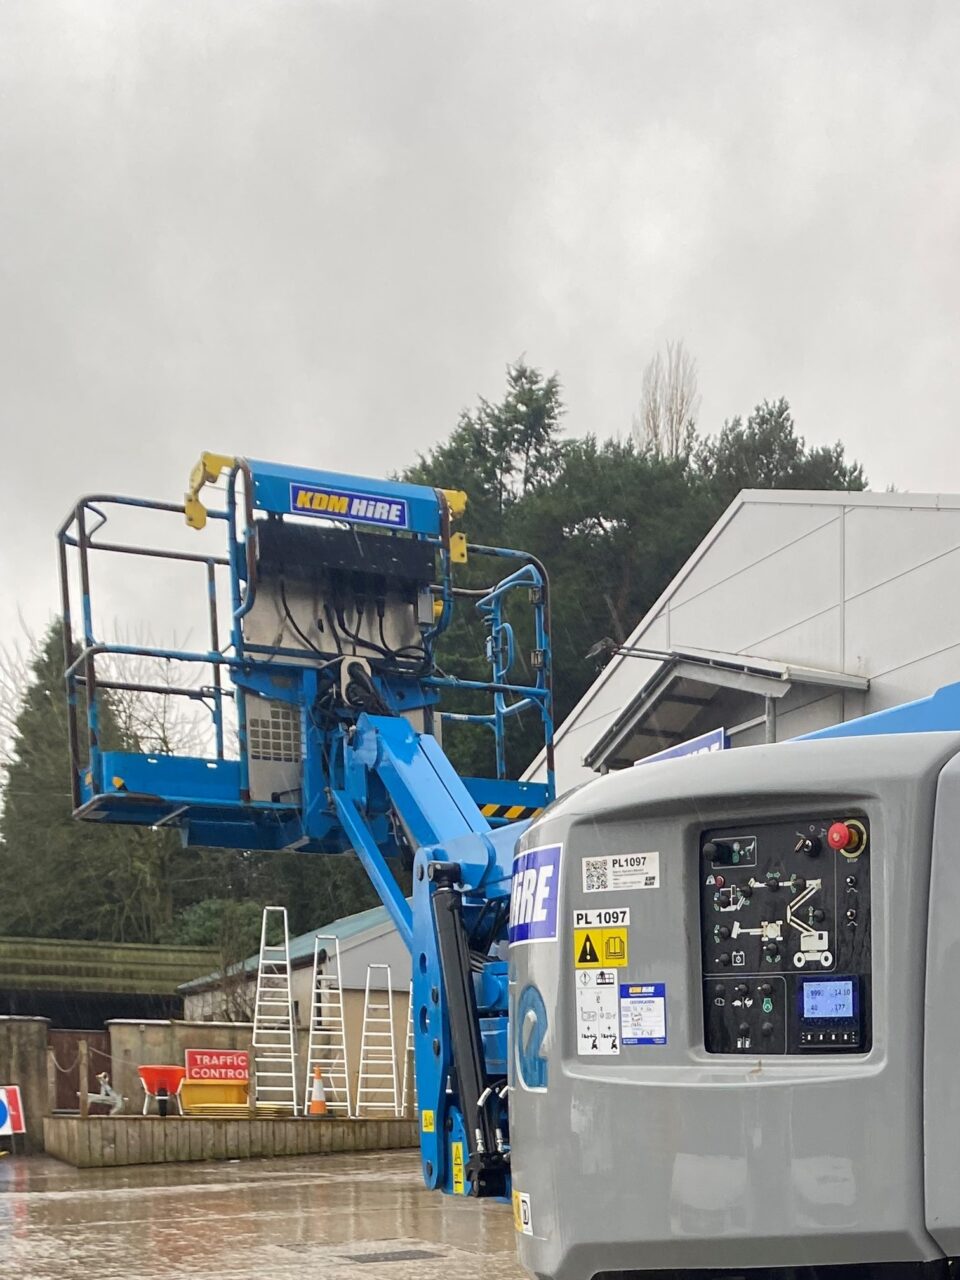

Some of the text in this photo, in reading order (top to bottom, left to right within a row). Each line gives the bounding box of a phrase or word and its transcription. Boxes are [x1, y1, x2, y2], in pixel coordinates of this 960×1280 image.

[296, 490, 349, 514] KDM
[612, 857, 647, 868] PL1097
[576, 911, 627, 925] PL 1097
[195, 1054, 247, 1066] TRAFFIC
